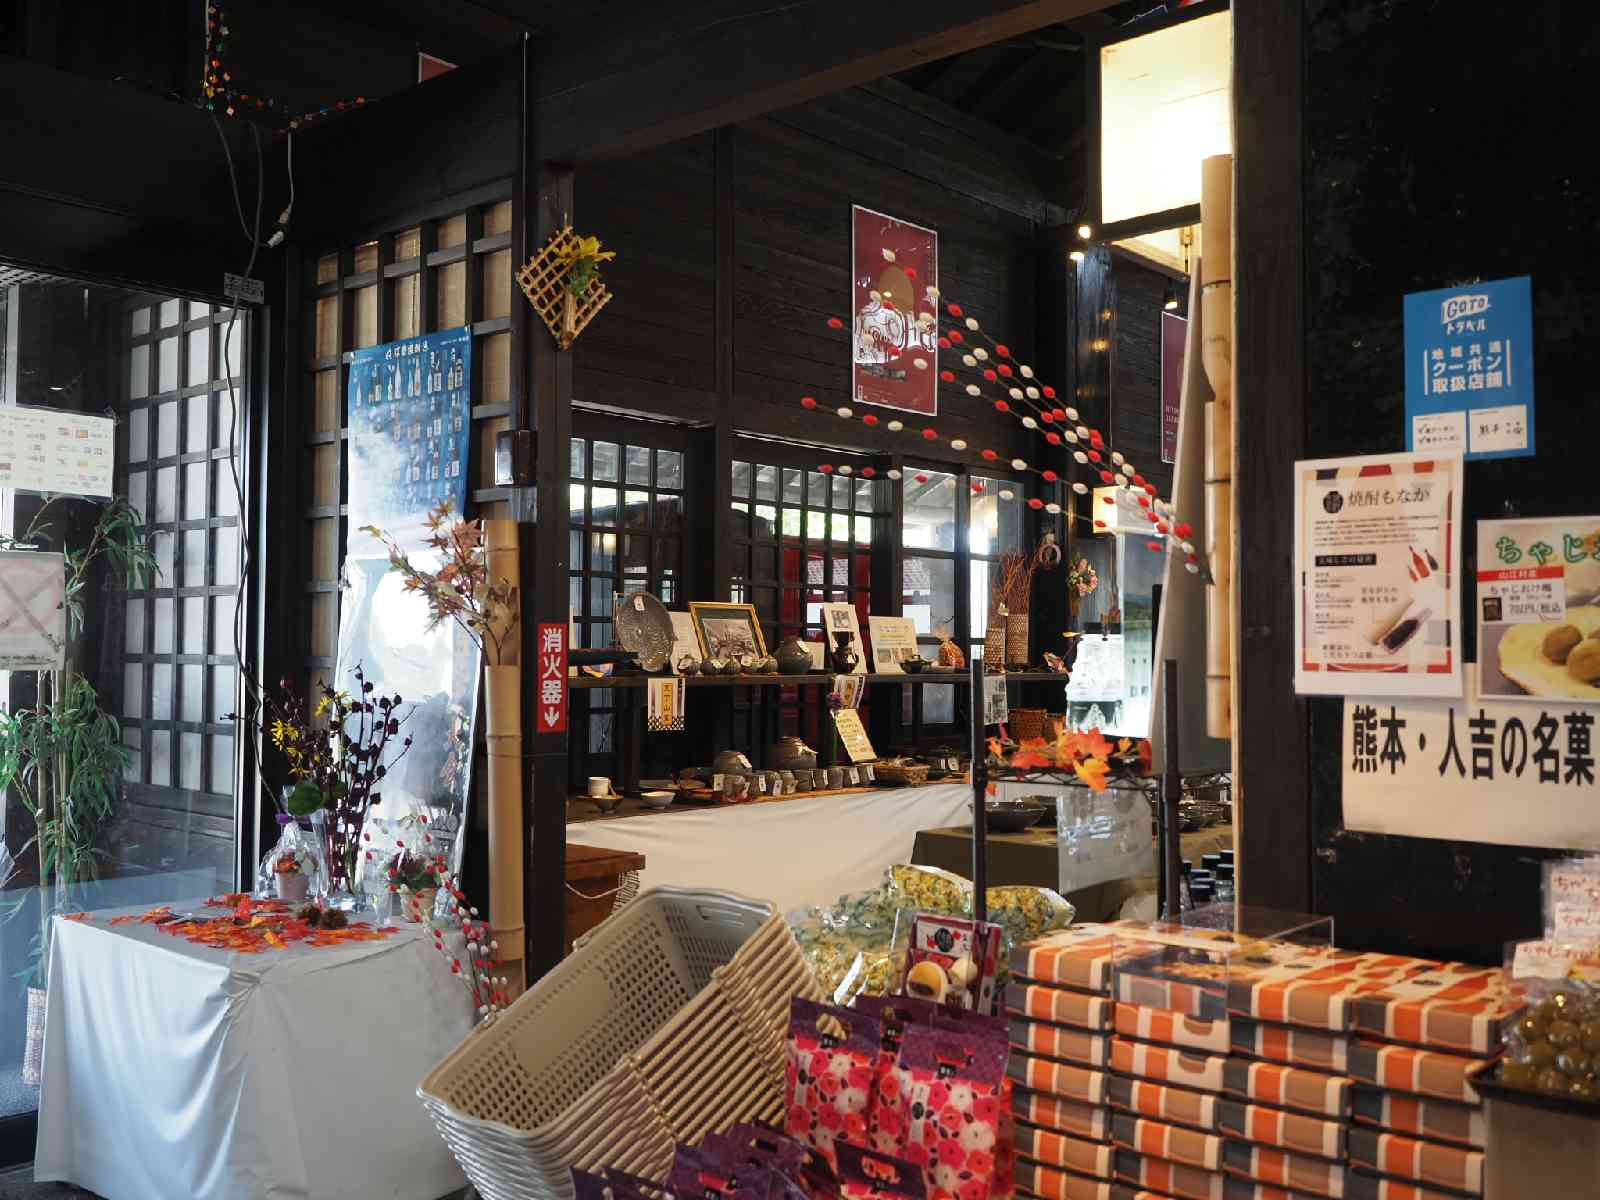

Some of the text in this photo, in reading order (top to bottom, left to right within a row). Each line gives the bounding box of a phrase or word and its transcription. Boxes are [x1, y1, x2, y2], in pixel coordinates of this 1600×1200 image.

[1447, 319, 1487, 335] トラベル
[1432, 340, 1502, 361] 地域共通
[1432, 356, 1502, 377] クーポン
[1432, 371, 1503, 394] 取扱店舗
[1348, 487, 1431, 507] 焼酎もなか
[1495, 533, 1600, 566] ちゃじ
[542, 627, 563, 705] 消火器
[1352, 704, 1595, 786] 熊本・人吉の名菓
